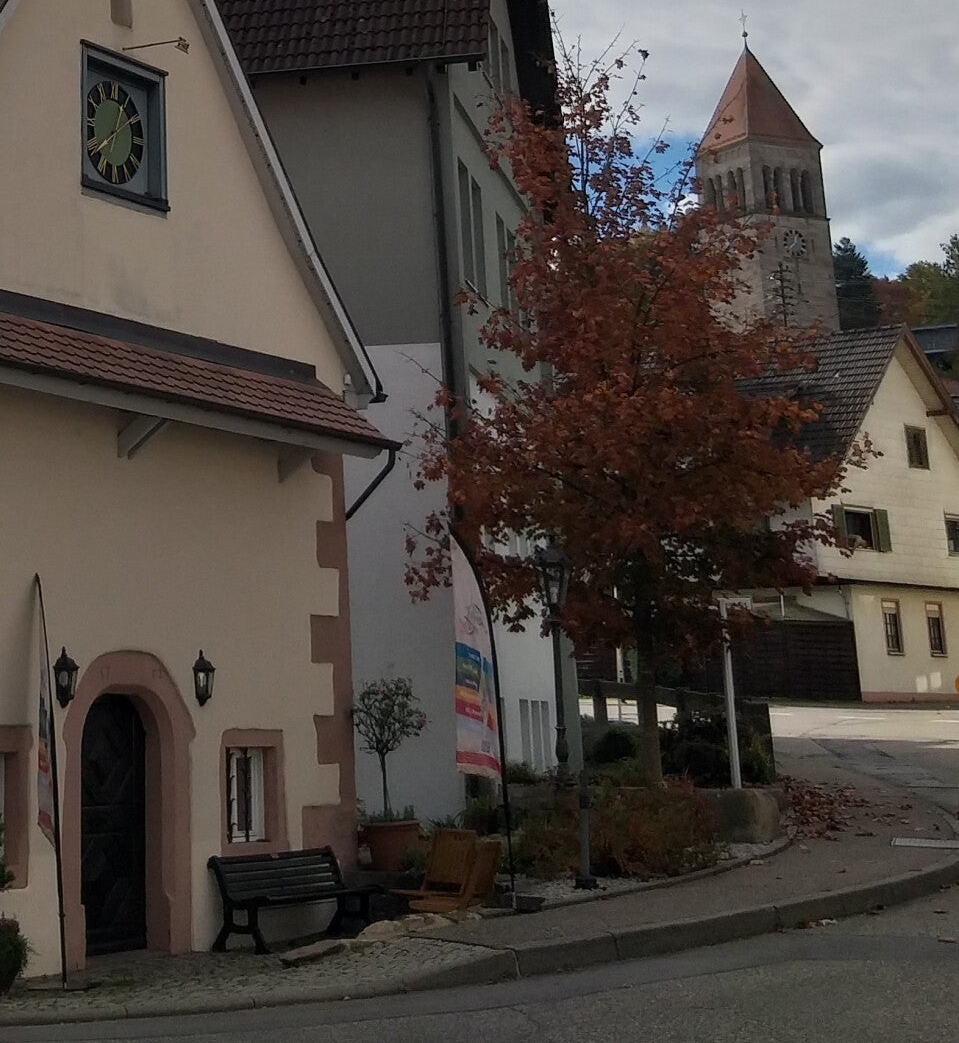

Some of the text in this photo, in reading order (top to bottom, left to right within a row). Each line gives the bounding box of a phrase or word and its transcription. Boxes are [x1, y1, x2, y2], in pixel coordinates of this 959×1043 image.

[96, 83, 107, 103] XI
[111, 81, 119, 100] XII
[88, 95, 101, 111] X
[124, 94, 131, 108] I
[86, 117, 96, 127] IX
[133, 136, 145, 145] III
[97, 155, 107, 176] VII
[112, 164, 119, 184] VI
[123, 163, 132, 182] V
